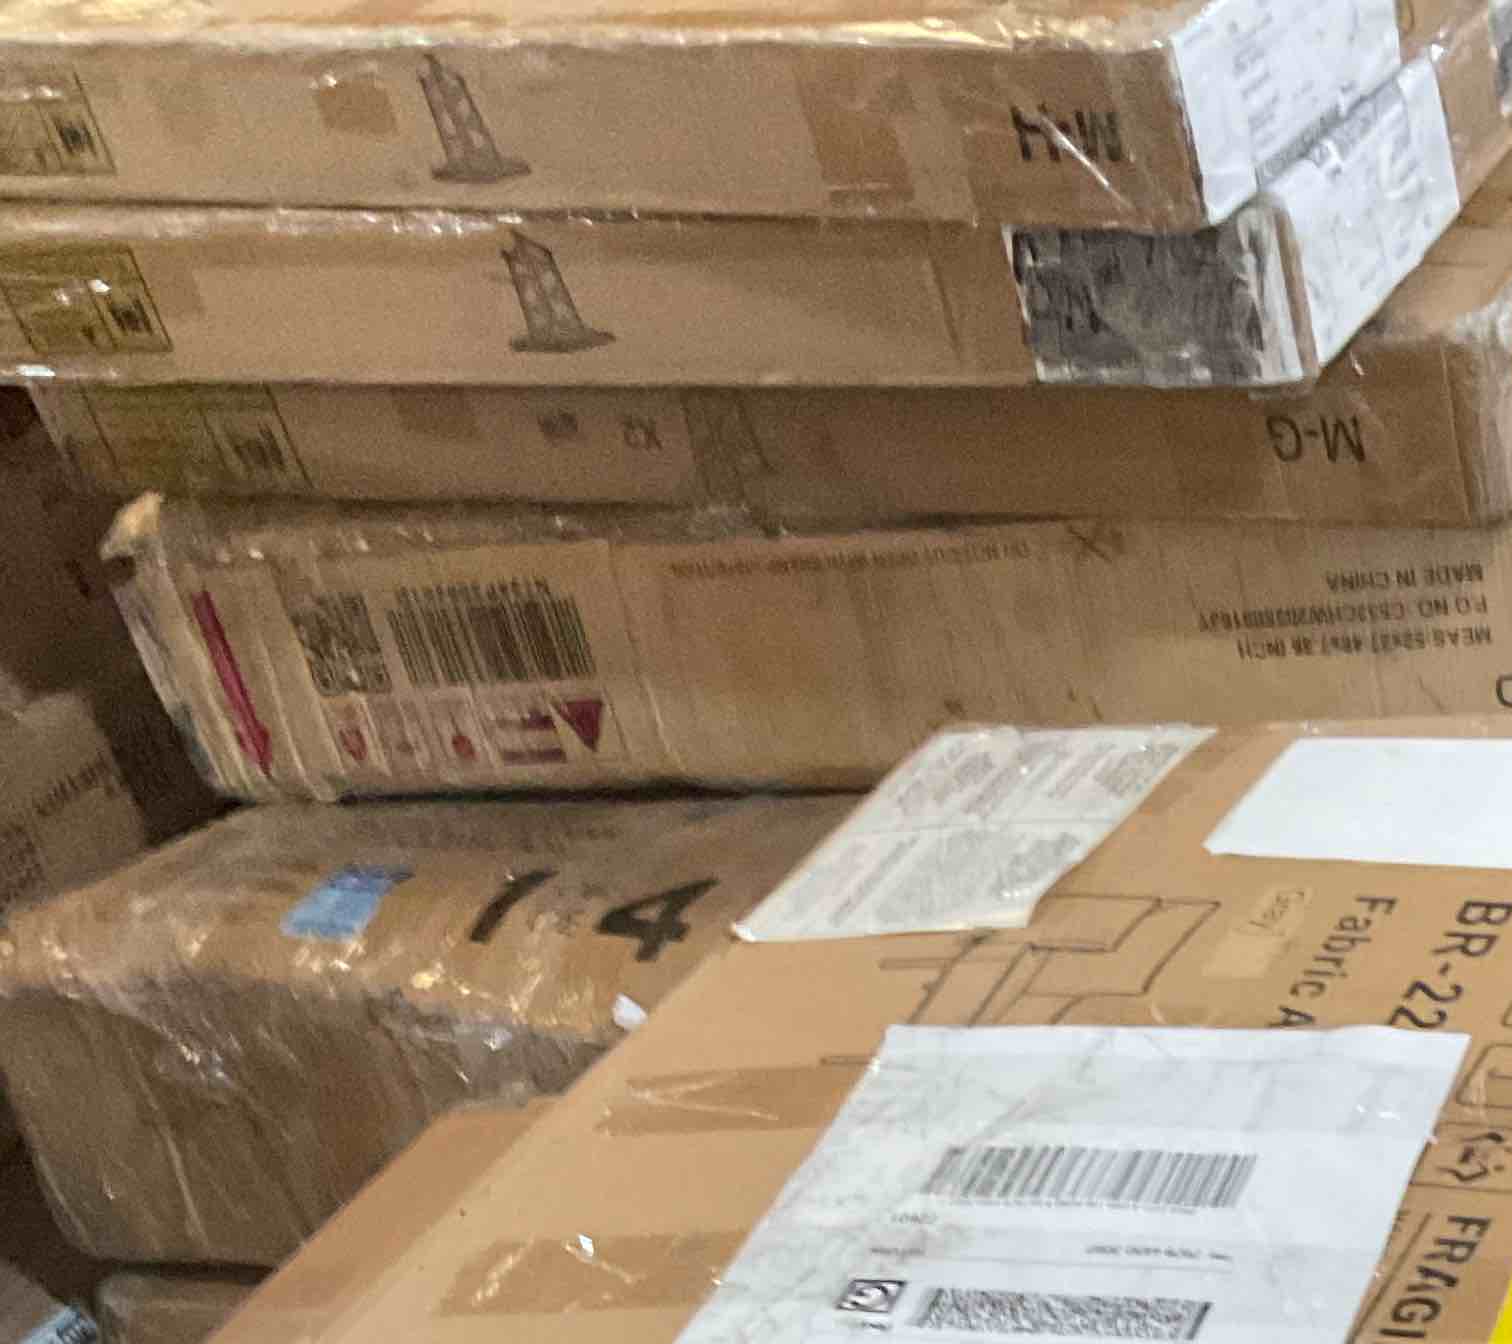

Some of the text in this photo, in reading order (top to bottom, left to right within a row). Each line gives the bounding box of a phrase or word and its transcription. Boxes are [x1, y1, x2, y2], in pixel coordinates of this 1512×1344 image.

[1265, 414, 1367, 464] M-G
[1430, 562, 1484, 589] MADE
[1289, 895, 1398, 1000] Fabric
